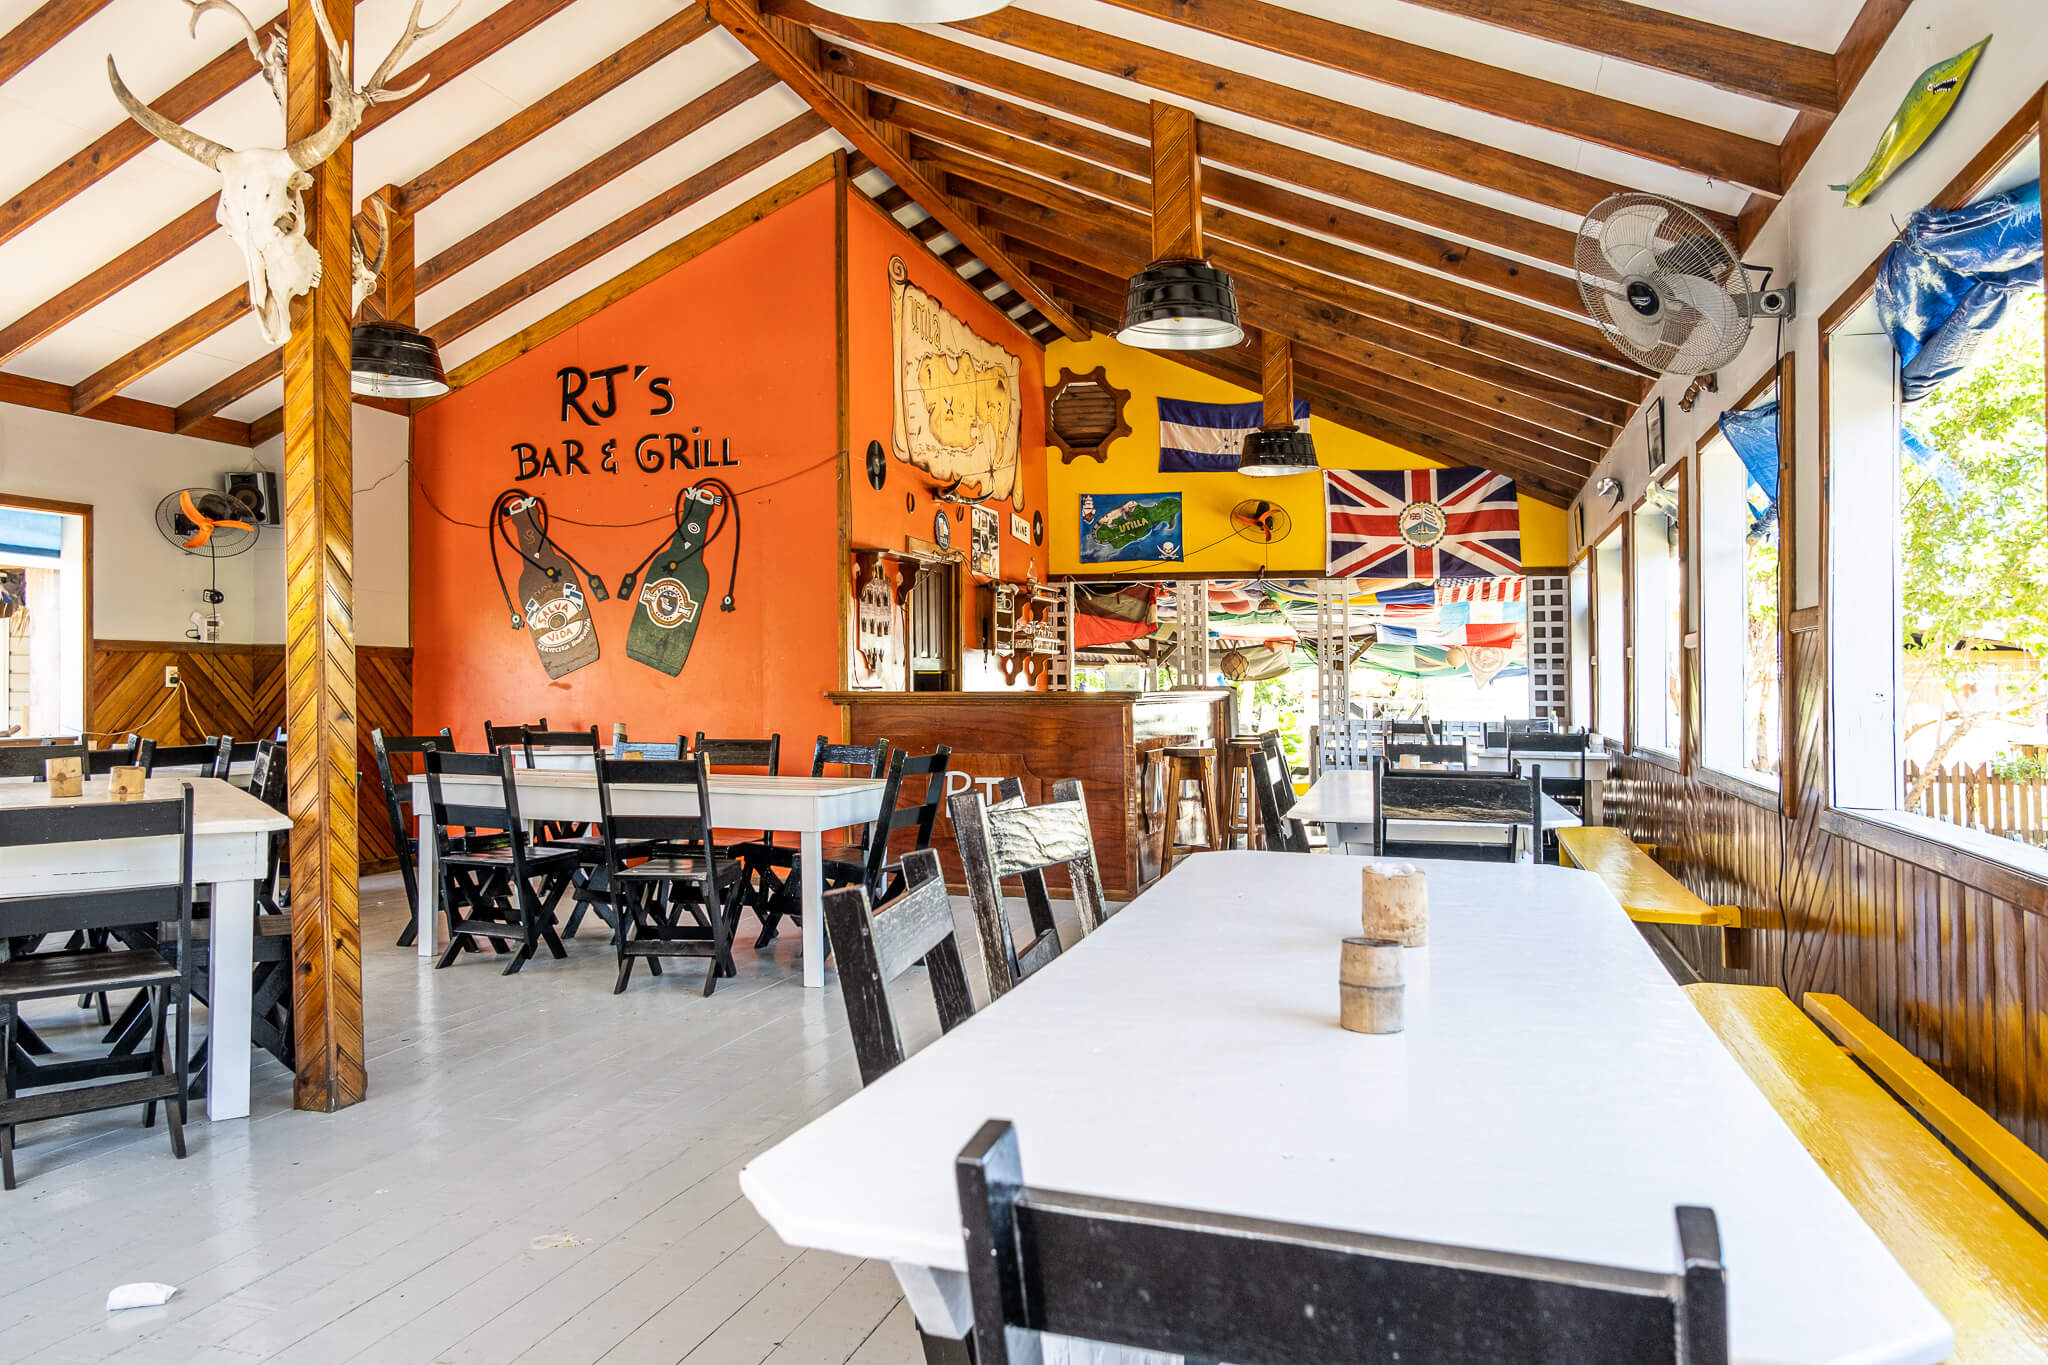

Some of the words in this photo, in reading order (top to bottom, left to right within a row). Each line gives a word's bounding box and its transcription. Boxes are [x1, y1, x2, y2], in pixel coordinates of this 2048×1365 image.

[511, 440, 591, 481] BAR
[601, 438, 619, 474] &
[1118, 517, 1149, 533] UTILLA
[537, 602, 569, 626] SALVA
